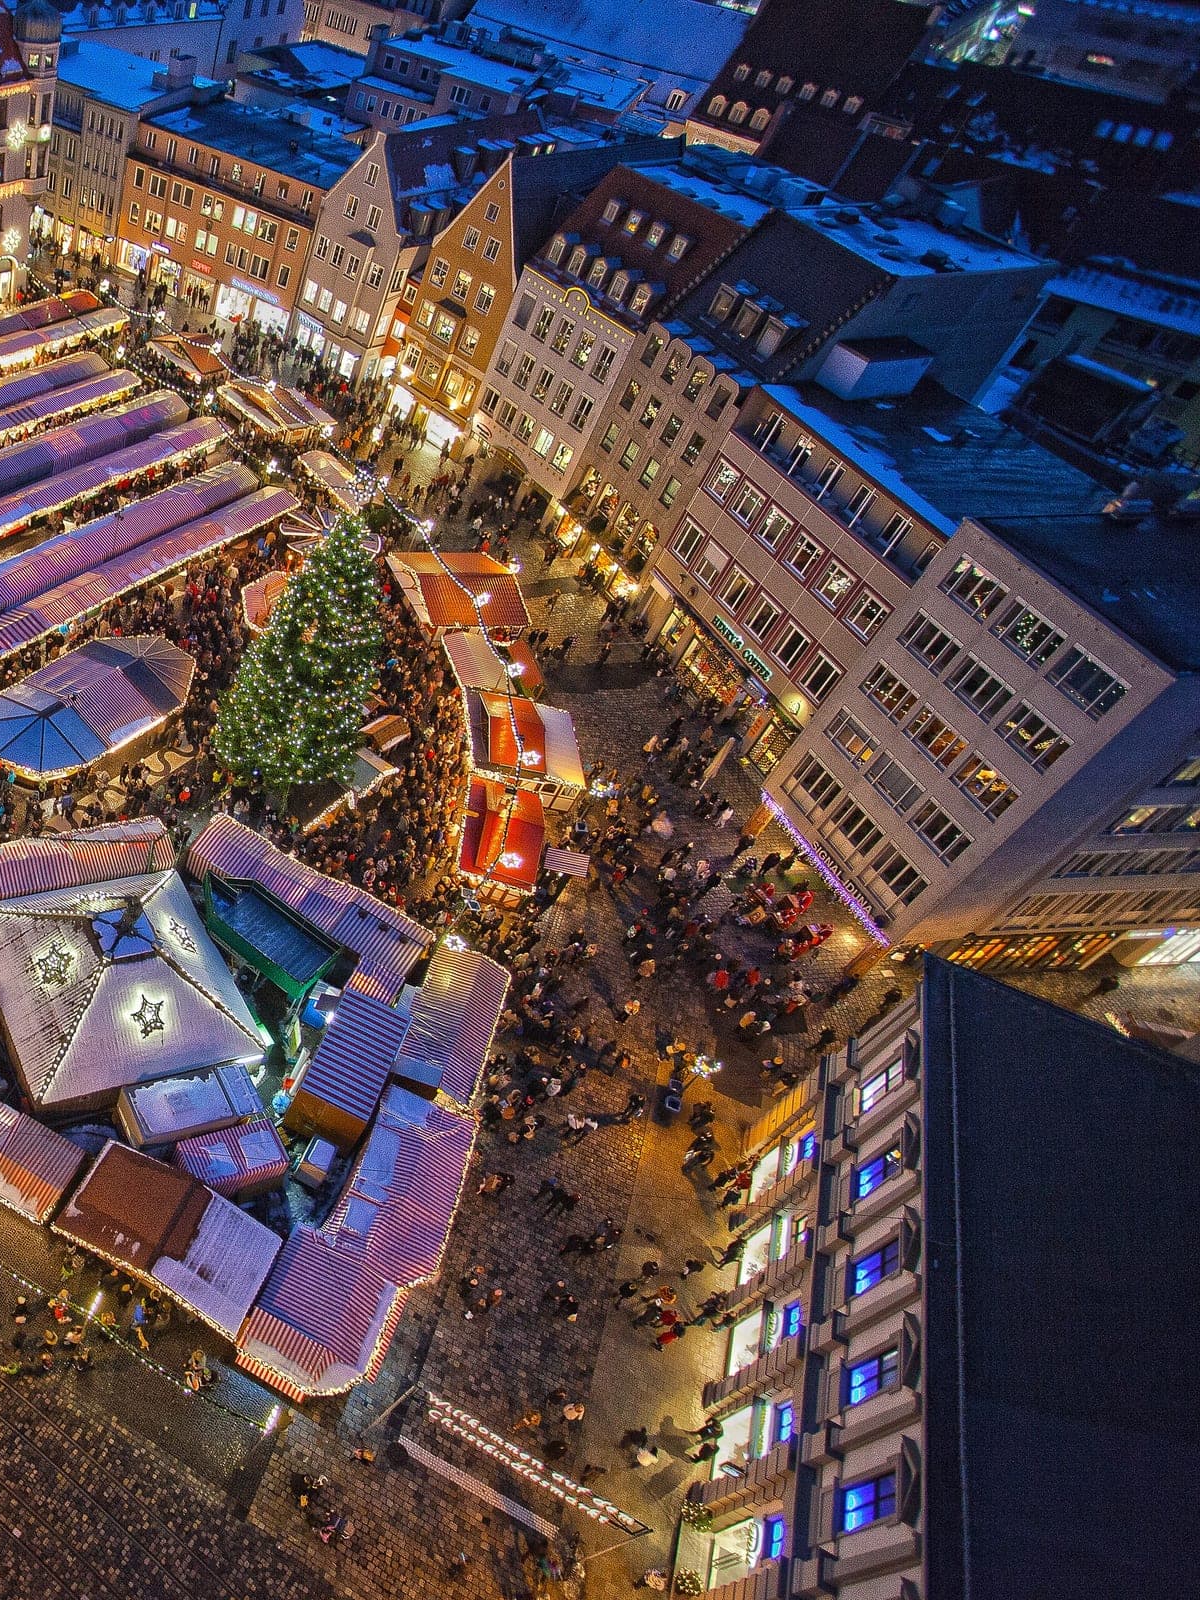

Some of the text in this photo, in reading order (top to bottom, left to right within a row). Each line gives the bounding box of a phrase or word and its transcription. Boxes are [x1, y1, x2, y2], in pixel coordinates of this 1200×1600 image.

[710, 614, 744, 651] HENRY'S
[742, 648, 773, 682] COFFEE
[812, 841, 873, 915] SIGNAL IDUNA
[426, 1390, 636, 1526] Willkommen auf dem
[428, 1408, 610, 1524] Christkindlesmarkt
